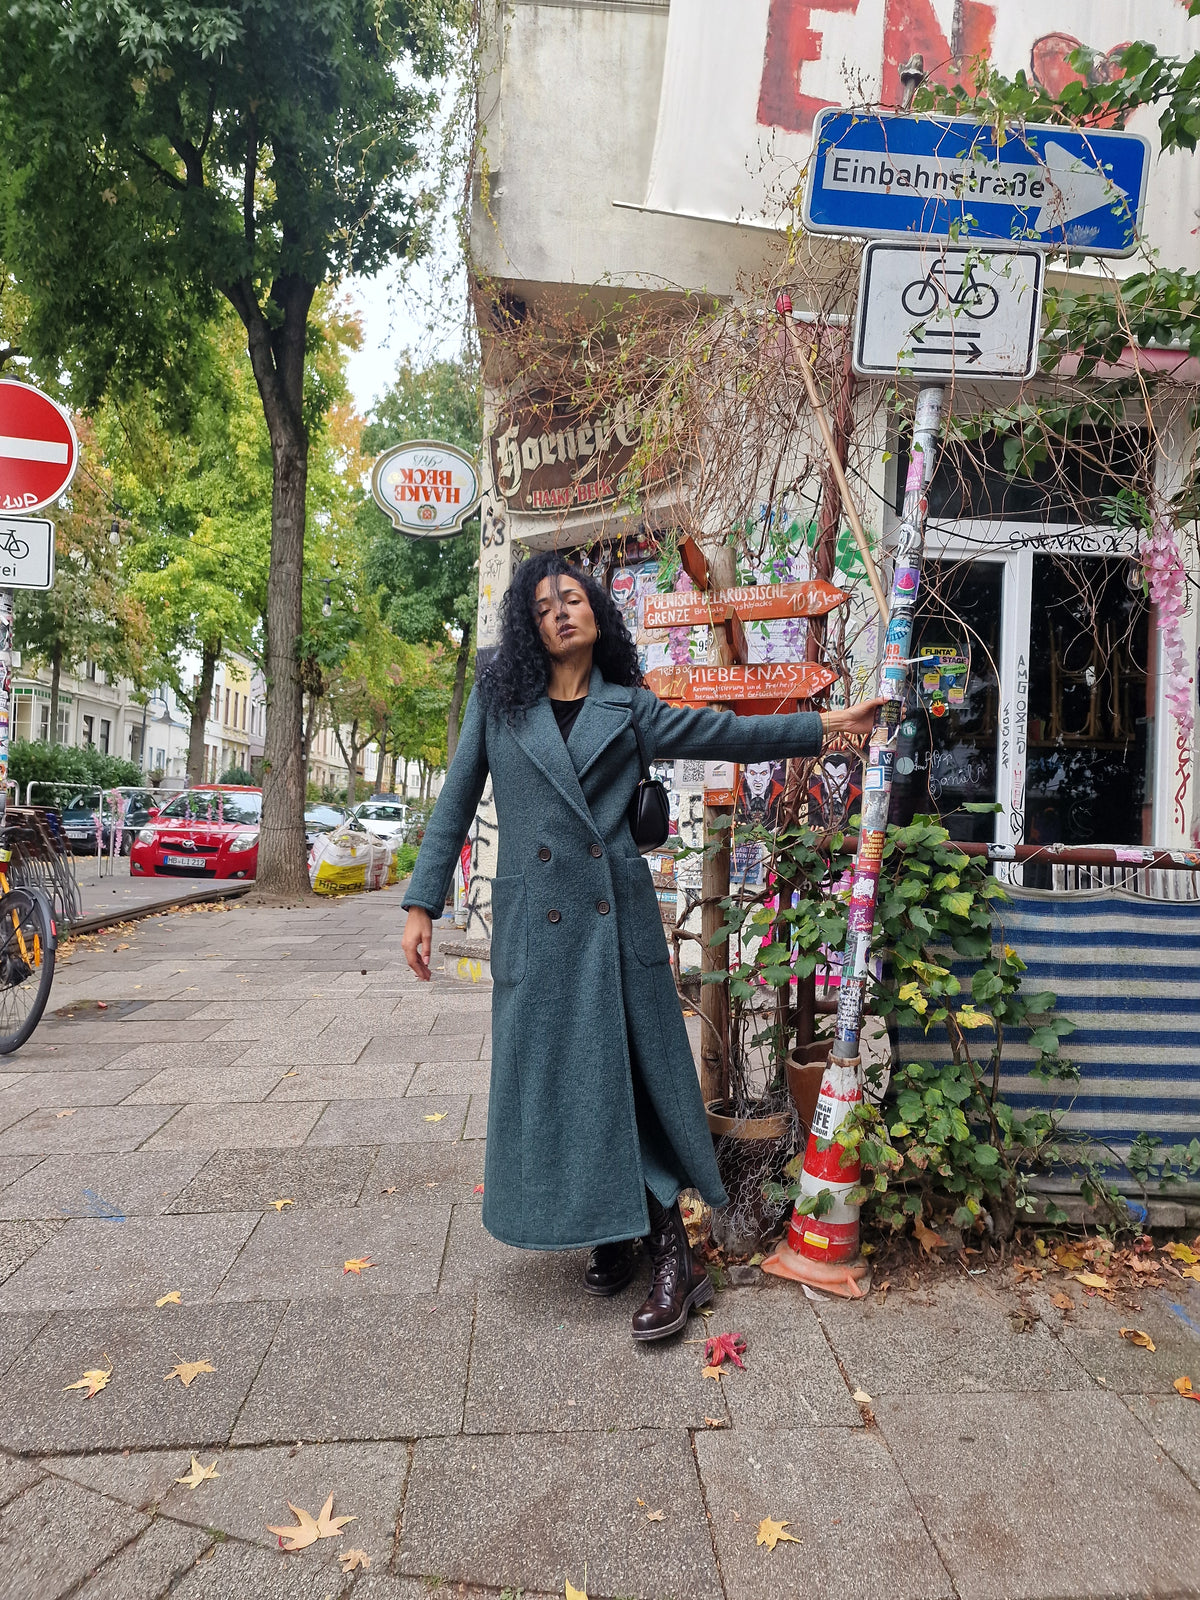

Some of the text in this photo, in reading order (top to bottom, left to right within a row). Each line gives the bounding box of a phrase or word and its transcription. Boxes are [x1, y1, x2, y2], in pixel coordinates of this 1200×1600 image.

[831, 157, 1046, 199] Einbahnstraße
[400, 468, 453, 486] BECK
[394, 485, 461, 504] HAAKE
[532, 486, 573, 509] HAAKE
[577, 476, 614, 504] BECK
[0, 563, 16, 577] ei
[733, 600, 774, 612] ushbacks
[647, 608, 691, 627] GRENZE
[942, 656, 967, 664] STAGE
